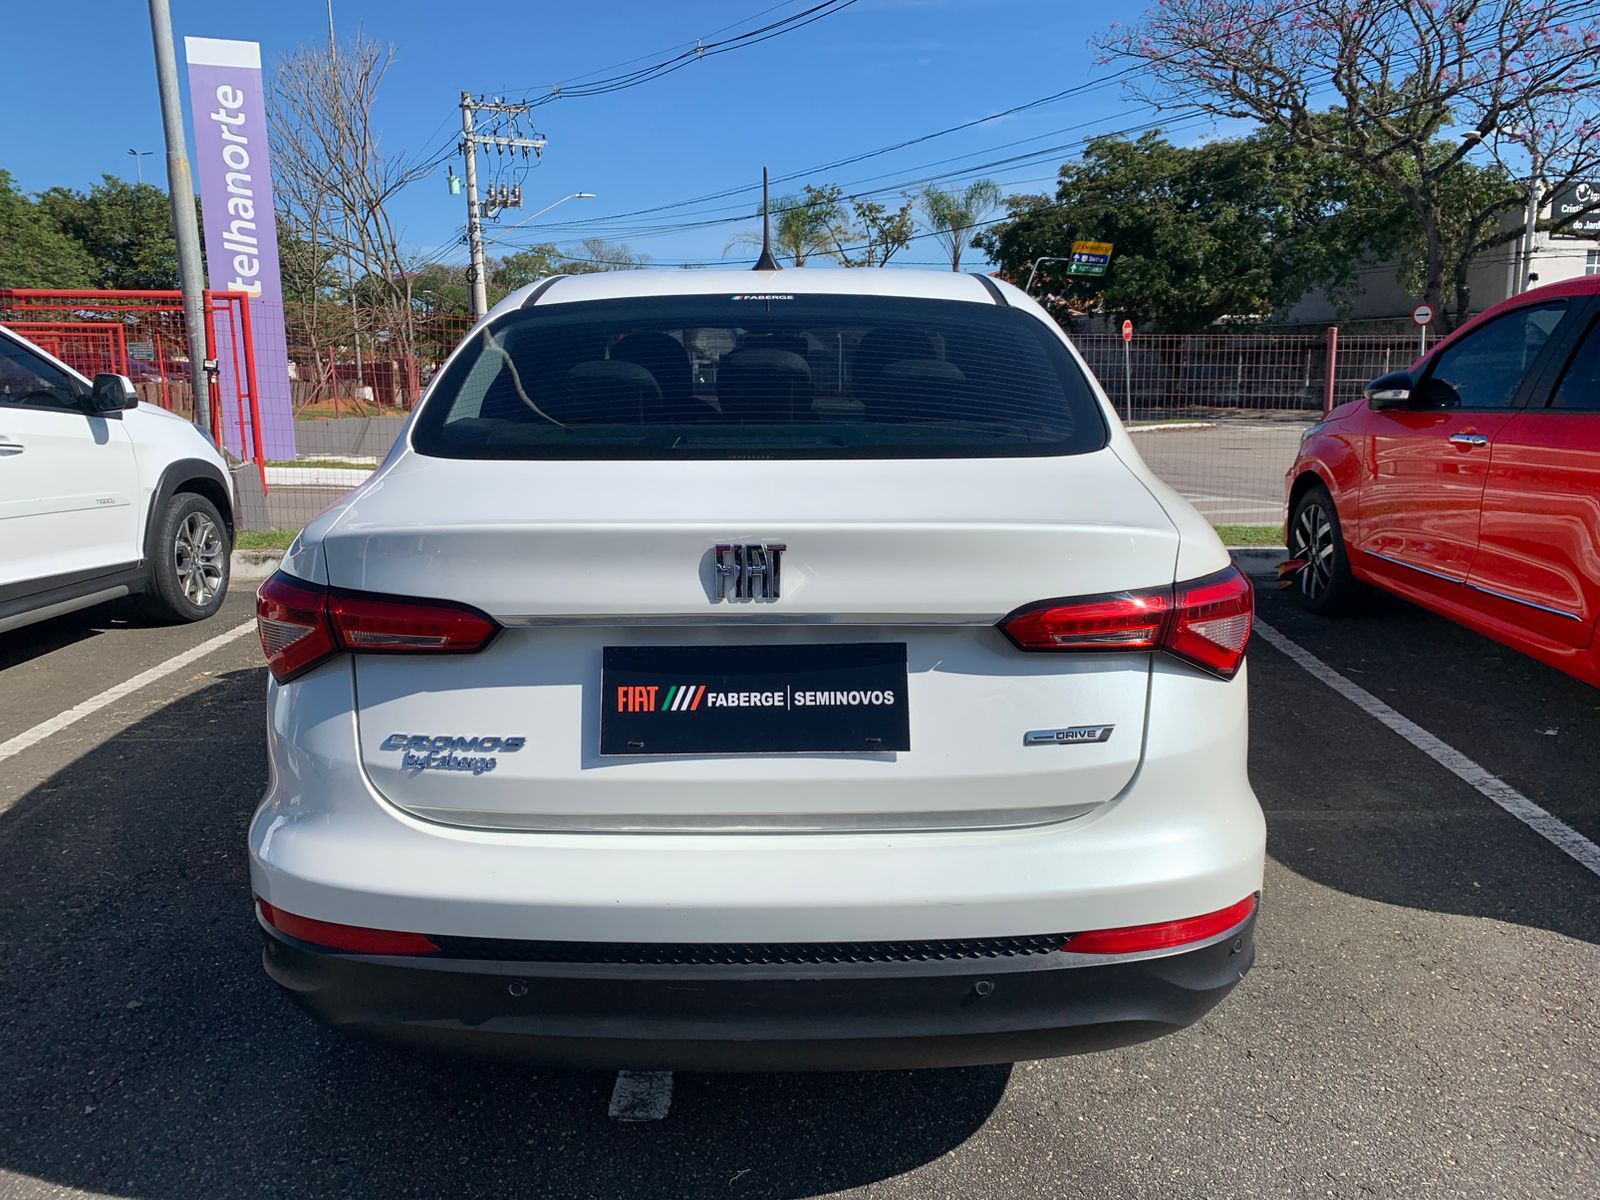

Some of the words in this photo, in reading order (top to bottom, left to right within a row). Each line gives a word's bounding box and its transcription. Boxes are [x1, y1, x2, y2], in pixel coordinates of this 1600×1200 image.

[210, 84, 262, 298] telhanorte
[1573, 220, 1583, 229] do
[714, 543, 787, 600] FIAT
[617, 686, 659, 712] FIAT
[707, 692, 784, 707] FABERGE
[794, 690, 895, 706] SEMINOVOS
[380, 734, 527, 752] CRONOS
[1055, 730, 1097, 740] DRIVE
